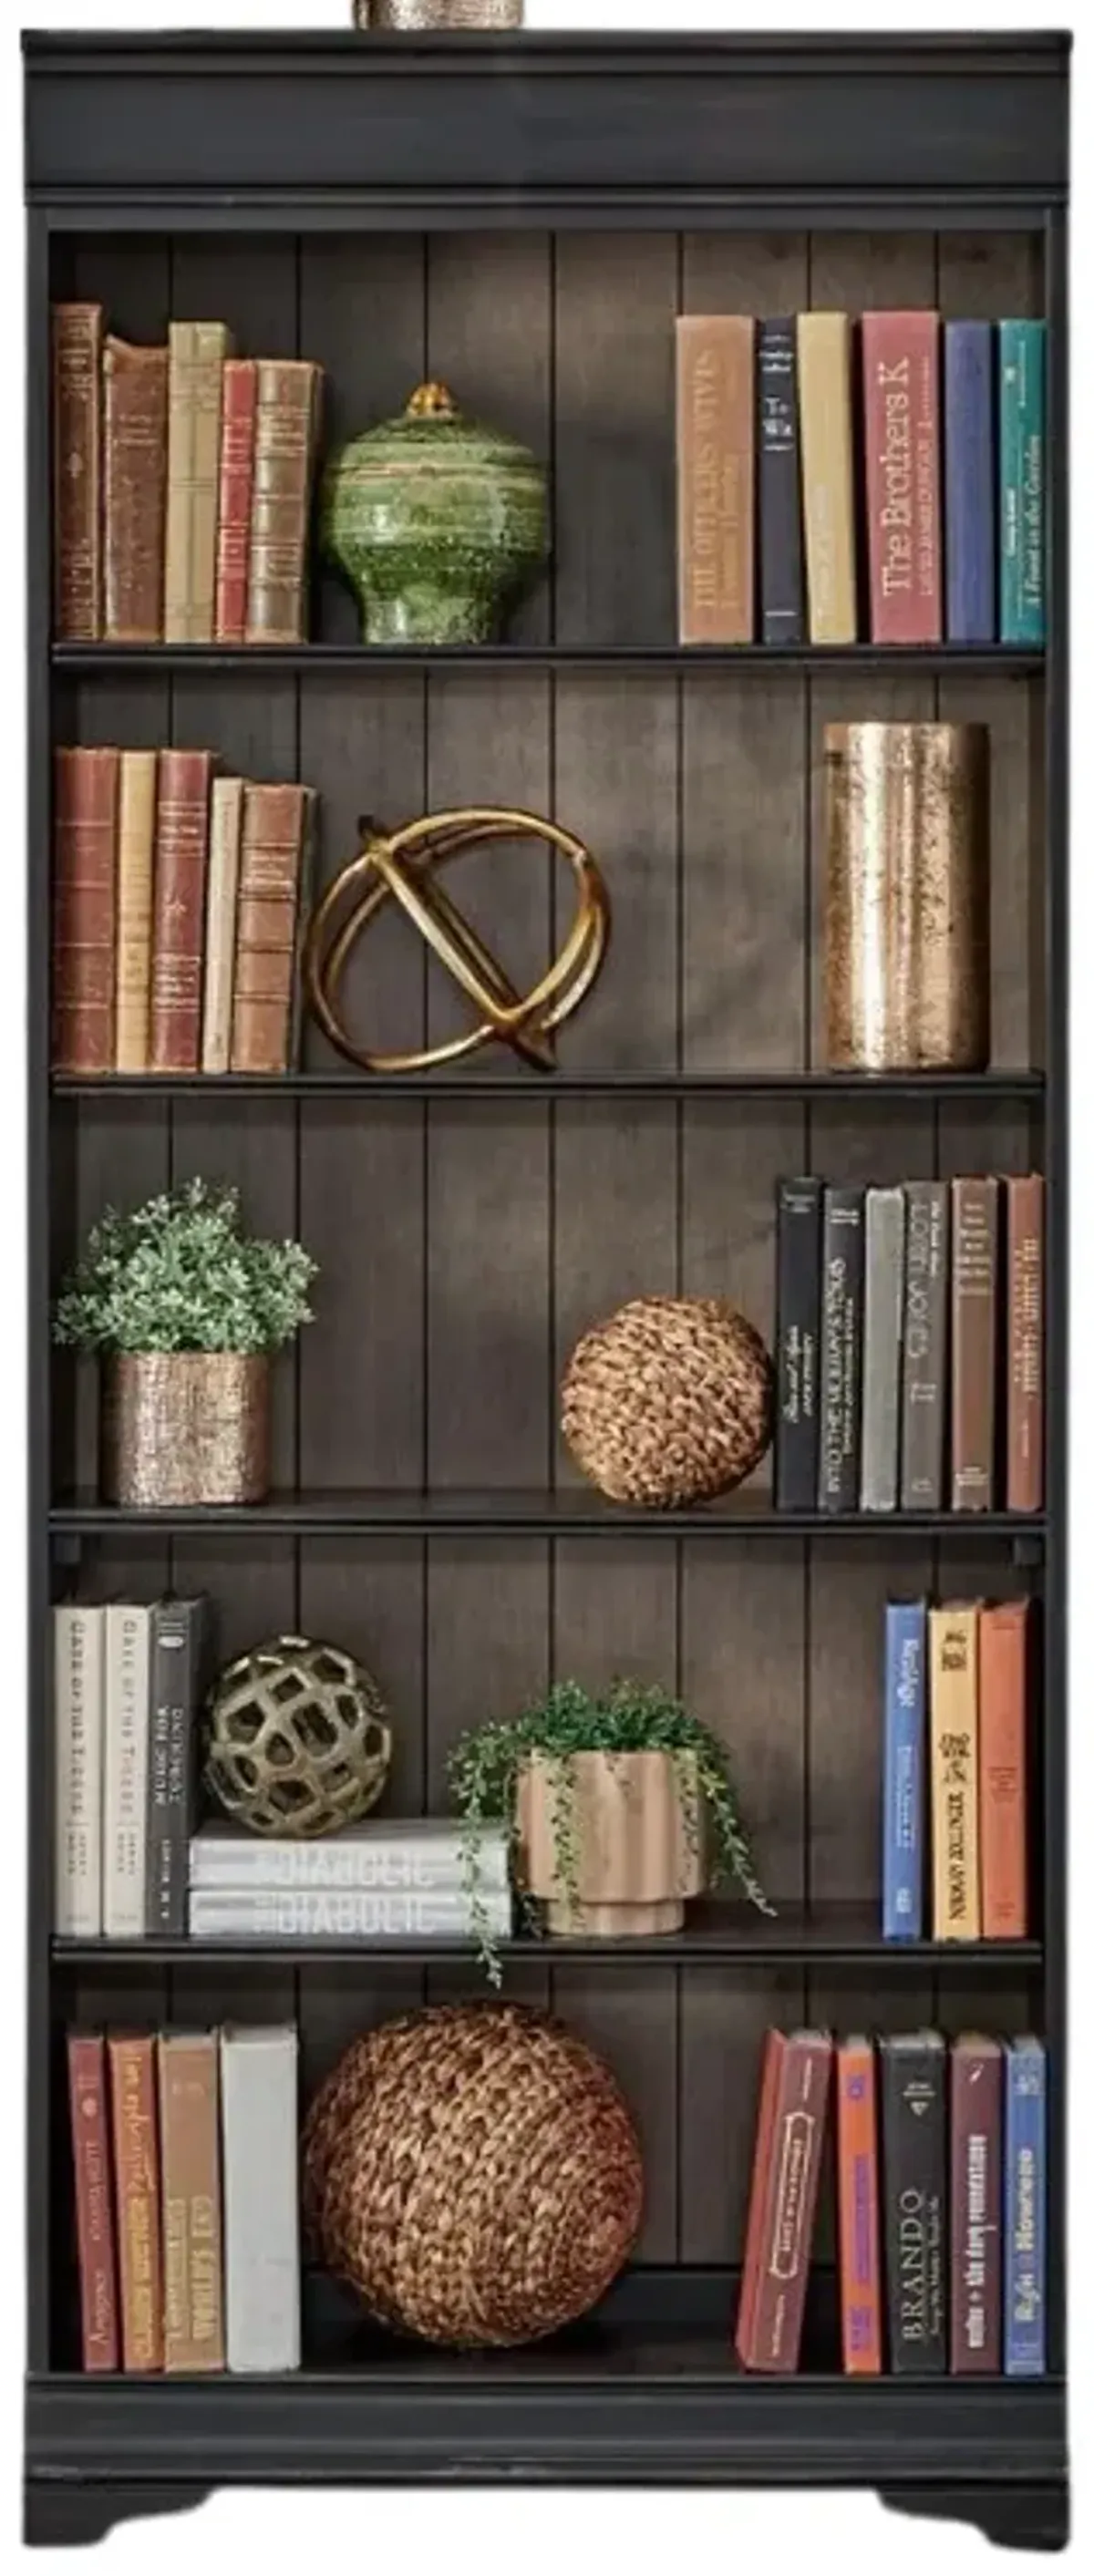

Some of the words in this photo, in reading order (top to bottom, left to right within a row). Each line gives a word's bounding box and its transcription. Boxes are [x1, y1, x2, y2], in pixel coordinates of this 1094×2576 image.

[878, 355, 910, 386] K
[879, 392, 912, 527] Brothers
[881, 533, 912, 596] The
[899, 2190, 926, 2341] BRANDO
